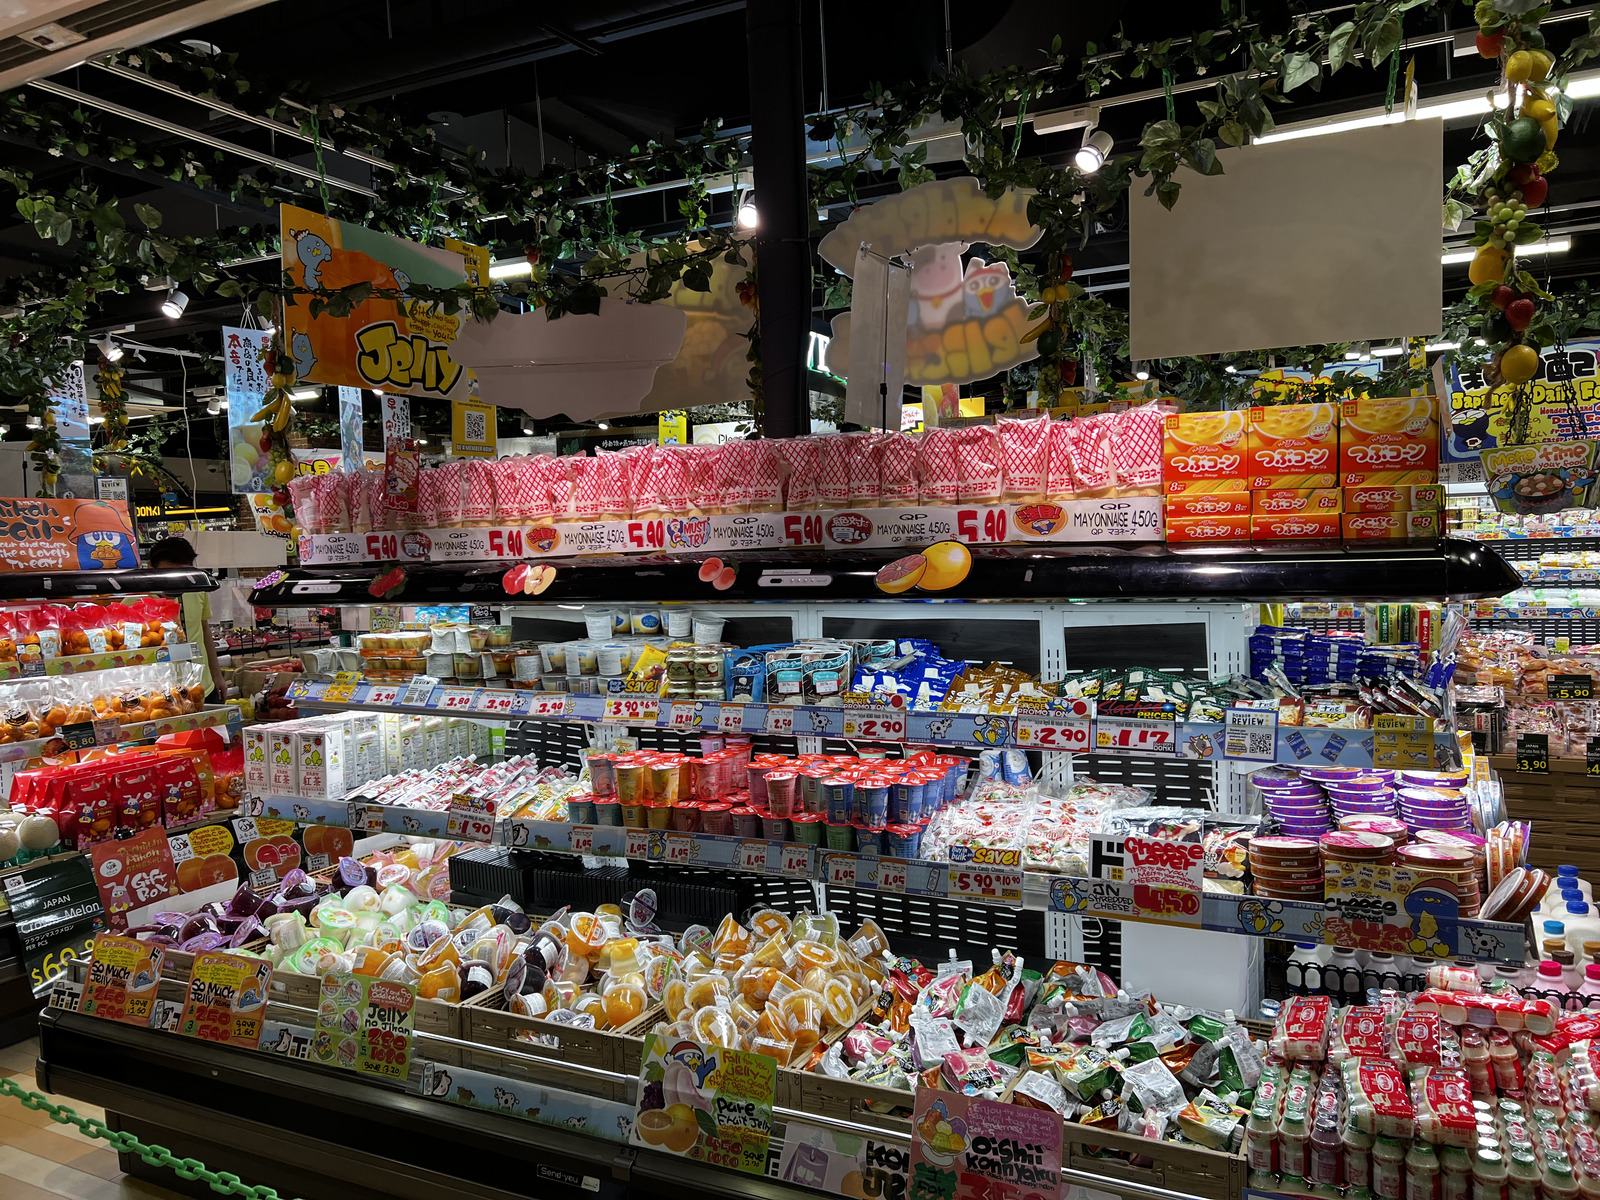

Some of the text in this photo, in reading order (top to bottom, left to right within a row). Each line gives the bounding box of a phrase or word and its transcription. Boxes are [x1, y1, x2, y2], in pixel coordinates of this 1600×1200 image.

[356, 322, 463, 395] Jelly
[1255, 449, 1329, 467] つぶコーン
[1348, 444, 1427, 463] つぶコーン
[1491, 444, 1588, 469] More time
[1170, 455, 1240, 473] つぶコーン
[1511, 464, 1536, 474] enjoy
[1539, 461, 1561, 471] your
[1563, 458, 1587, 467] food
[1352, 491, 1403, 502] つぶコーン
[1185, 502, 1231, 514] つぶコーン
[1259, 498, 1307, 511] つぶコーン
[1074, 510, 1157, 528] MAYONNAISE 450G
[1349, 517, 1400, 529] つぶコーン
[683, 523, 707, 535] MUST
[713, 524, 774, 538] MAYONNAISE 450G
[876, 523, 950, 535] MAYONNAISE 450G
[1107, 528, 1136, 536] マヨネーズ
[1185, 525, 1231, 537] つぶコーン
[1271, 523, 1319, 536] つぶコーン
[156, 532, 163, 541] 6
[565, 531, 624, 545] MAYONNAISE 450G
[687, 534, 706, 547] TRY
[434, 540, 484, 551] MAYONNAISE 450G
[28, 548, 71, 558] Lovely
[5, 557, 63, 570] Treat!
[1556, 689, 1589, 699] $5.90
[1097, 700, 1163, 715] Slashed
[1137, 711, 1174, 720] PRICES
[1232, 717, 1264, 726] REVIEW
[857, 720, 903, 736] $2.90
[1377, 720, 1406, 728] REVIEW
[1019, 728, 1031, 737] 25%
[1033, 727, 1087, 746] $2.90
[1098, 732, 1111, 740] 70%
[69, 736, 95, 750] 8.80
[1516, 759, 1547, 771] $3.90
[249, 771, 265, 782] 紅茶
[274, 773, 290, 784] 紅茶
[303, 776, 321, 786] 紅茶
[458, 820, 492, 835] $1.90
[1124, 837, 1204, 860] Cheese
[951, 848, 1021, 866] bulk Save!
[1132, 852, 1197, 871] Lover
[131, 868, 168, 889] Gift
[953, 872, 993, 891] $5.90
[1128, 877, 1160, 886] CHEESE
[1093, 883, 1120, 896] JN
[42, 894, 71, 910] JAPAN
[1088, 895, 1134, 905] SHREDDED
[1134, 884, 1200, 915] 4.50
[64, 902, 100, 918] Melon
[1093, 902, 1131, 912] CHEESE
[26, 939, 49, 951] PER PCS
[91, 973, 112, 988] Jelly
[371, 984, 389, 994] Juicy
[400, 988, 412, 998] So
[191, 992, 214, 1008] Jelly
[368, 1003, 408, 1025] Jelly
[365, 1018, 410, 1035] no Jikan
[368, 1028, 407, 1050] 280
[722, 1051, 753, 1066] Fall for
[716, 1097, 755, 1116] Pure
[972, 1103, 1002, 1117] Enjoy
[717, 1114, 771, 1133] Fruit Jelly
[981, 1121, 1023, 1134] tenderness
[1006, 1115, 1038, 1129] taste
[540, 1165, 579, 1184] Send-you
[965, 1152, 1057, 1185] konnyaku
